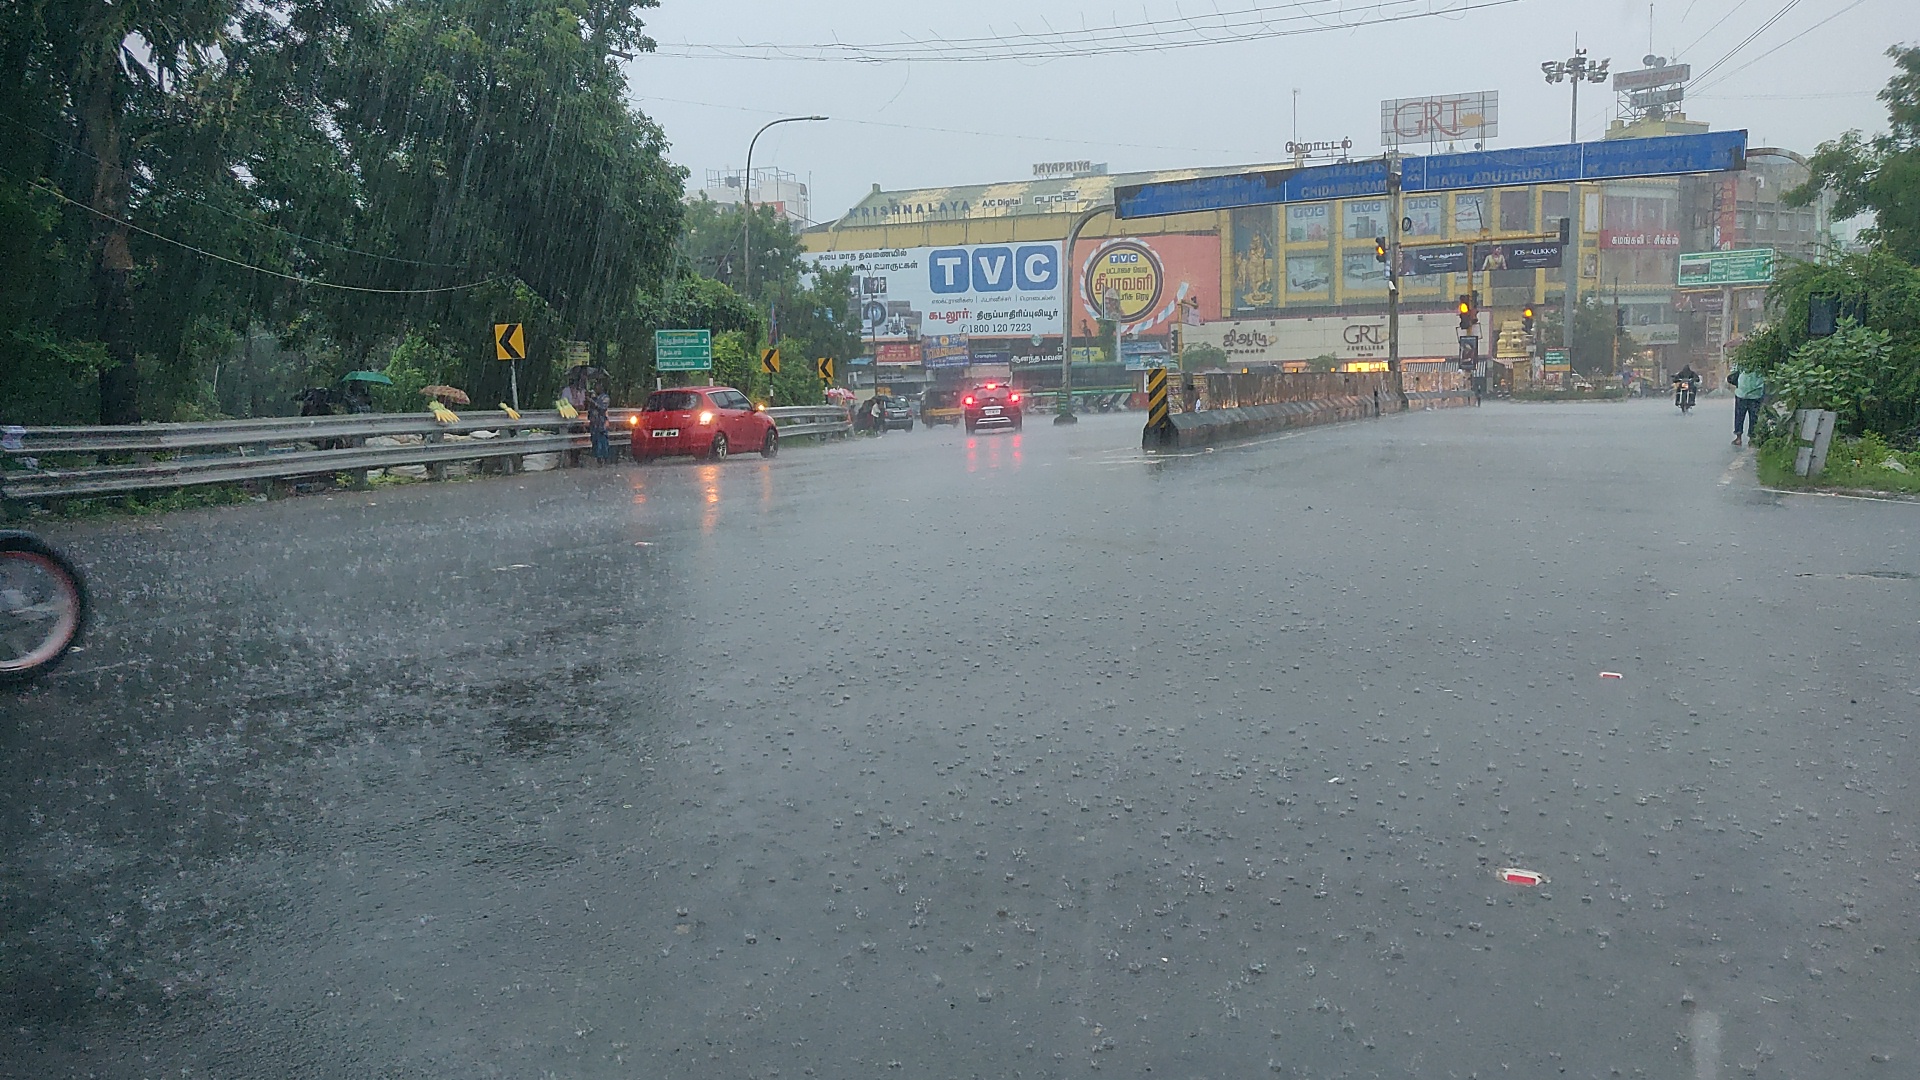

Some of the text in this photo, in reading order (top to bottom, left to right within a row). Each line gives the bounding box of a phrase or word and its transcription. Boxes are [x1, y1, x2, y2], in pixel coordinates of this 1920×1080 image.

[1393, 98, 1470, 137] GRT
[1033, 160, 1090, 175] JAYAPRIYA
[1428, 167, 1559, 188] MAYILADUTHURAI
[1301, 180, 1387, 198] CHIDAMBARAM
[849, 200, 971, 218] KRISHNALAYA
[982, 197, 1021, 207] A/C Digital
[1352, 203, 1380, 212] TVC
[1409, 200, 1437, 208] TVC
[1295, 207, 1324, 217] TVC
[839, 253, 856, 261] மாத
[858, 248, 907, 261] தவணையில்
[1110, 254, 1138, 263] TVC
[874, 260, 918, 271] பொருட்கள்
[935, 252, 1052, 287] TVC
[1095, 273, 1153, 293] தீபாவளி
[976, 308, 1059, 323] திருப்பாதிரிப்புலியூர்
[969, 323, 1032, 333] 1800 120 7223
[1343, 324, 1386, 345] GRT
[1011, 354, 1041, 364] ஆனந்த
